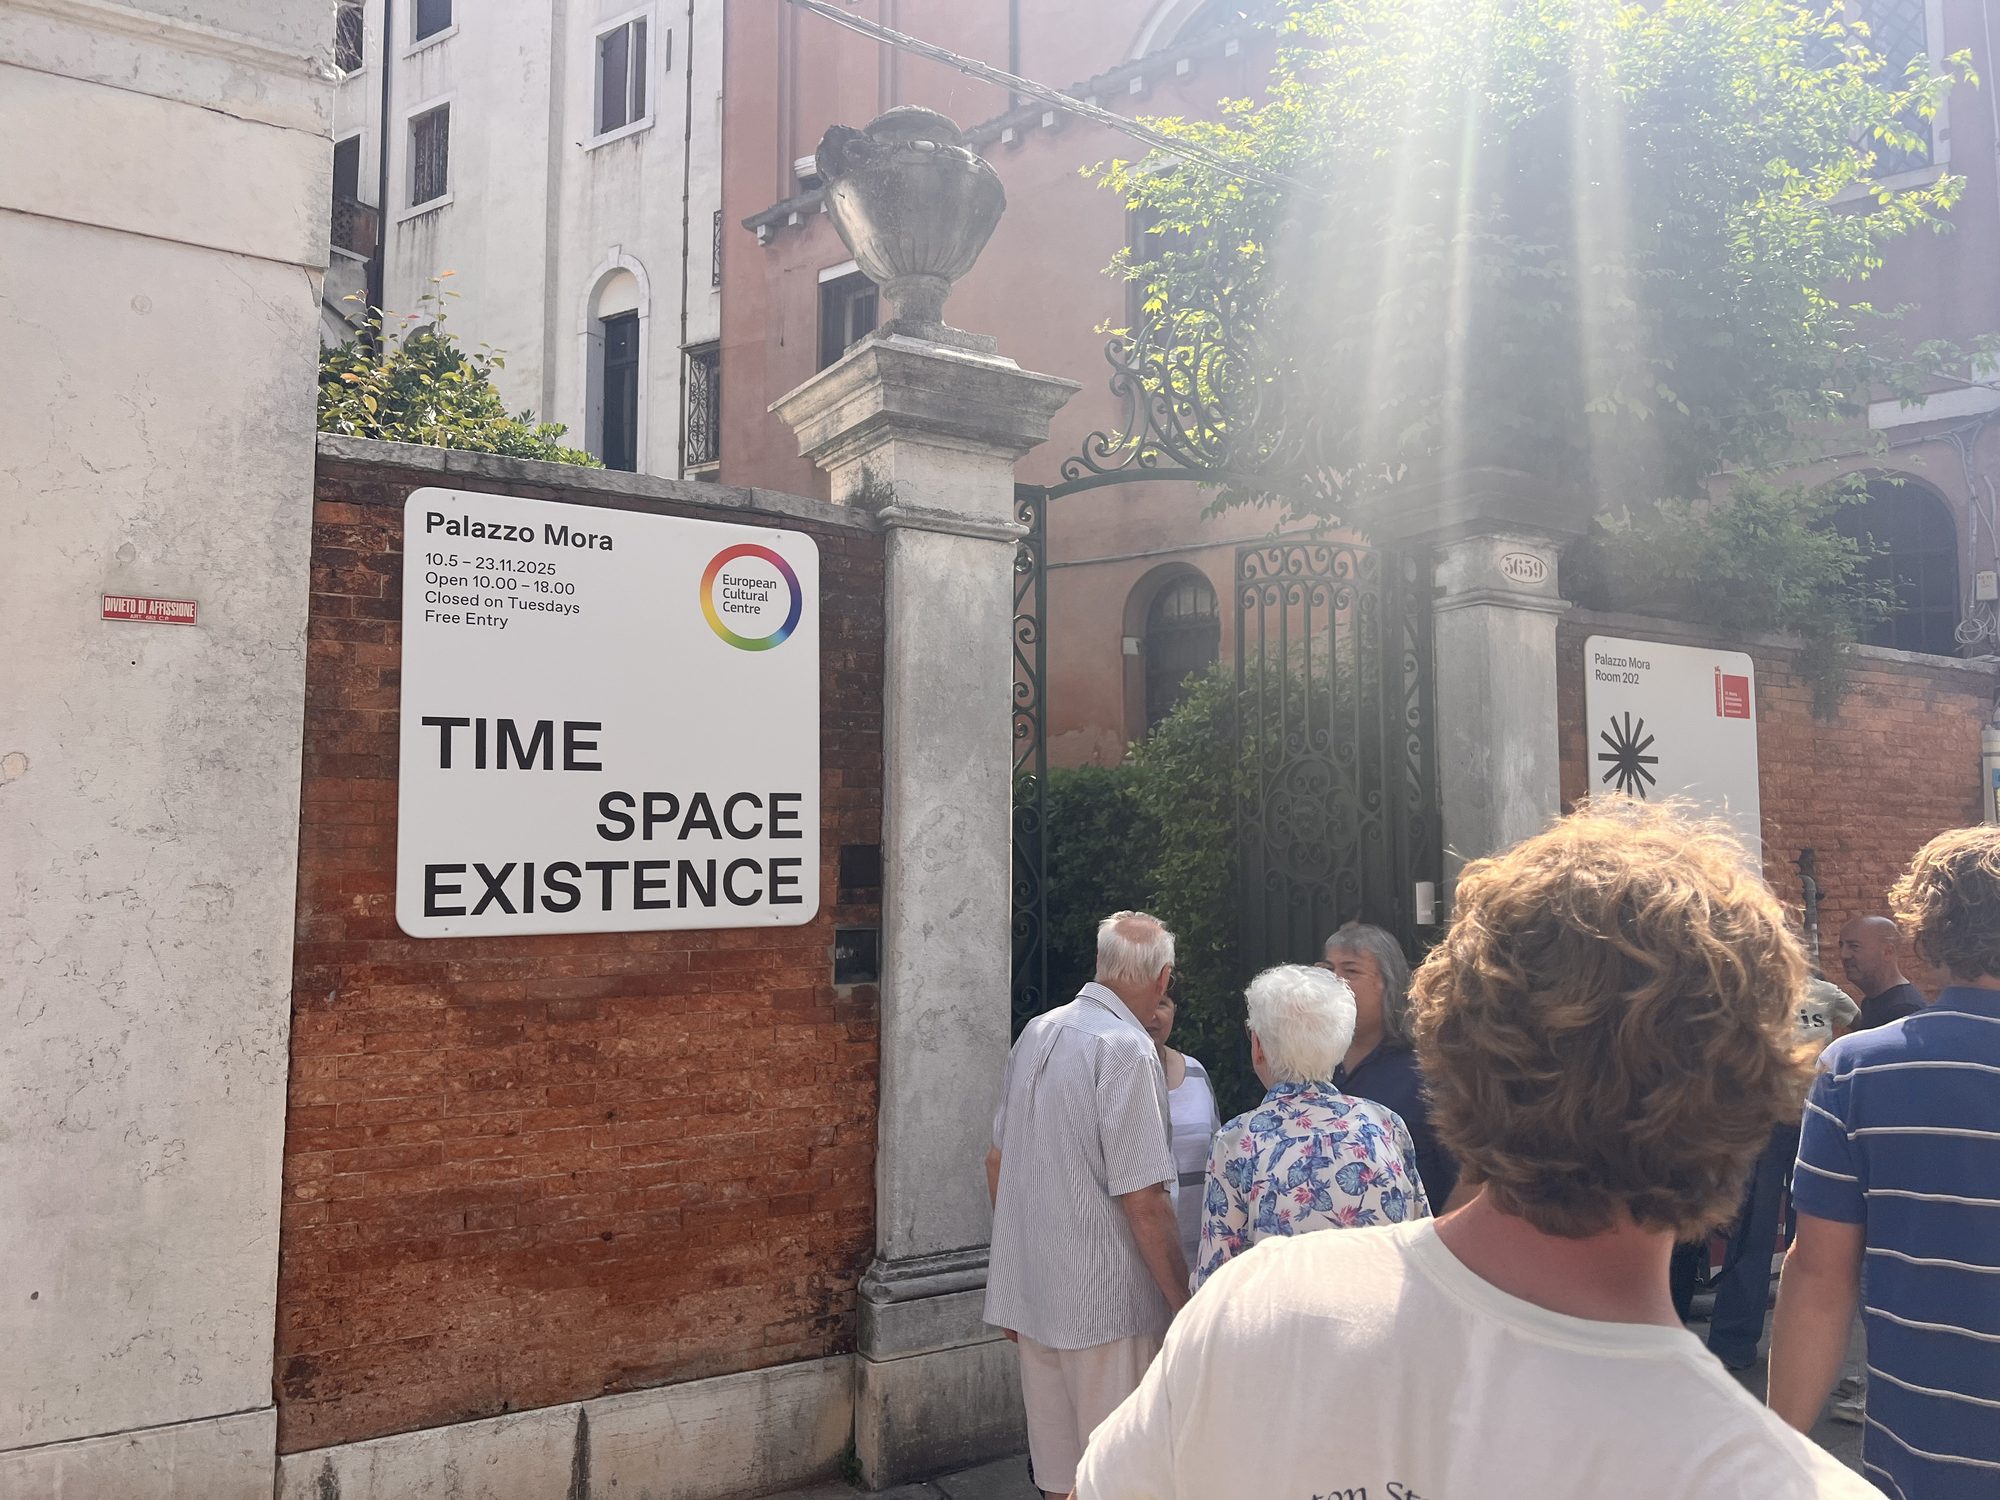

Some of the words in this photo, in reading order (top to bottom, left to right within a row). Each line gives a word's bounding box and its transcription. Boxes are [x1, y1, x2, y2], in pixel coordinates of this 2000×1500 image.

[426, 511, 535, 543] Palazzo
[544, 523, 613, 551] Mora
[425, 552, 458, 568] 10.5
[475, 556, 556, 576] 23.11.2025
[425, 571, 468, 589] Open
[472, 575, 517, 591] 10.00
[533, 580, 575, 596] 18.00
[722, 573, 777, 590] European
[425, 590, 480, 607] Closed
[484, 597, 503, 609] on
[507, 596, 580, 616] Tuesdays
[722, 587, 769, 602] Cultural
[104, 597, 136, 614] DIVIETO
[138, 600, 147, 614] DI
[149, 601, 194, 618] AFFISSIONE
[722, 601, 761, 615] Centre
[425, 609, 461, 624] Free
[465, 612, 509, 630] Entry
[1594, 652, 1627, 668] Palazzo
[1628, 656, 1650, 670] Mora
[1595, 669, 1621, 683] Room
[1622, 672, 1639, 685] 202
[421, 716, 603, 772] TIME
[596, 790, 803, 842] SPACE
[423, 857, 803, 918] EXISTENCE
